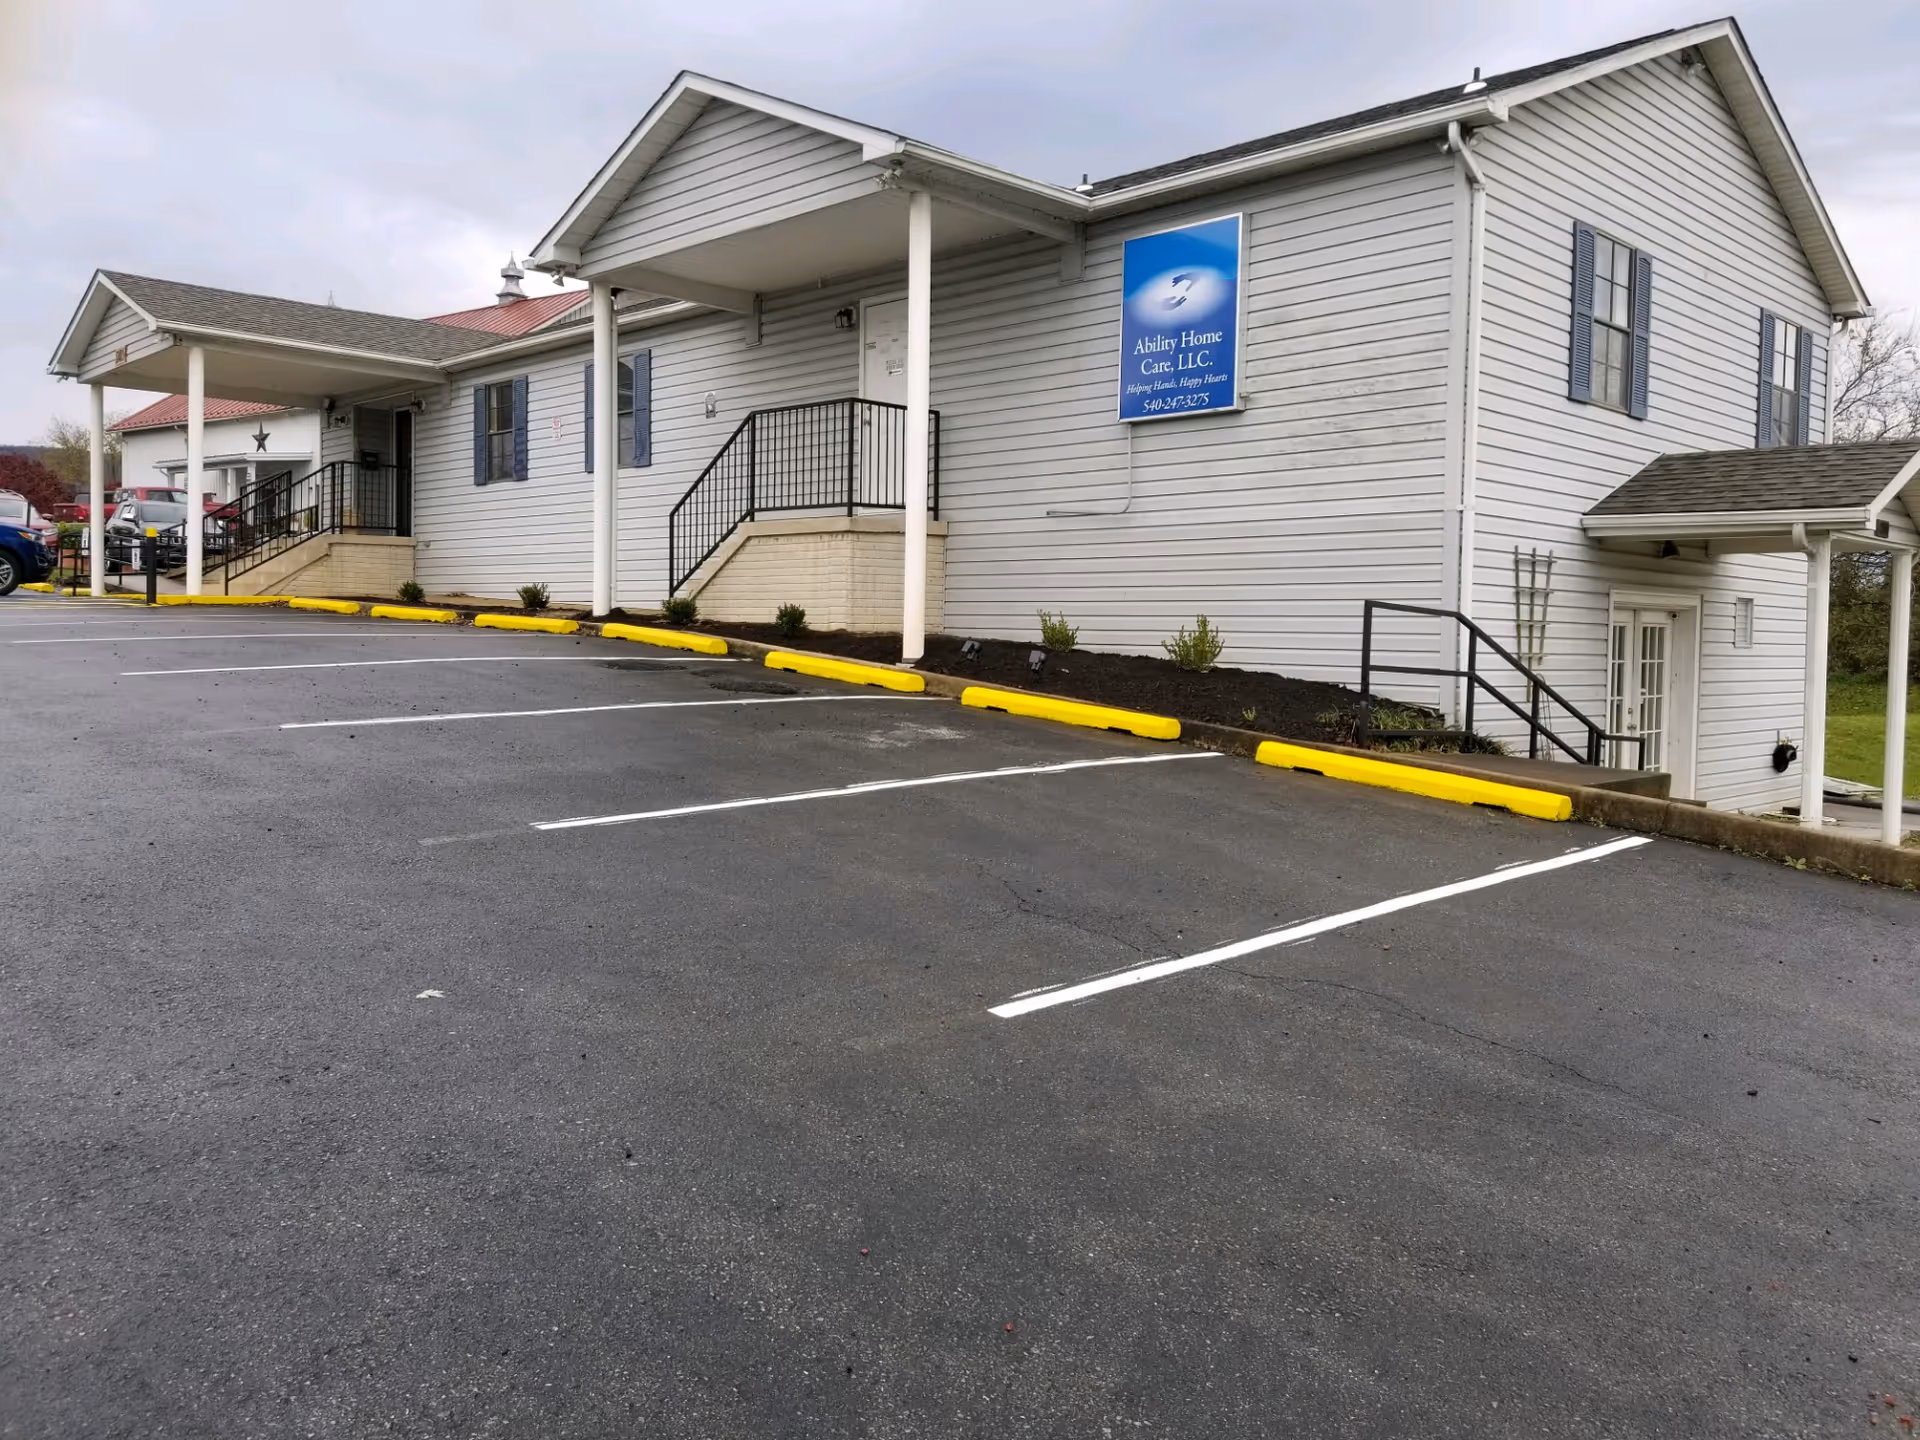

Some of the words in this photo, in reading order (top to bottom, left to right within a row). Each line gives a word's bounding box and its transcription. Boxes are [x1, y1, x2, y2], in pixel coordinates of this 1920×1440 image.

[1134, 334, 1178, 355] Ability
[1180, 330, 1223, 348] Home
[1141, 359, 1174, 375] Care,
[1178, 350, 1213, 370] LLC.
[1126, 384, 1153, 396] Helping
[1154, 379, 1178, 391] Hands,
[1180, 377, 1203, 389] Happy
[1204, 373, 1228, 384] Hearts
[1142, 392, 1210, 413] 540-247-3275
